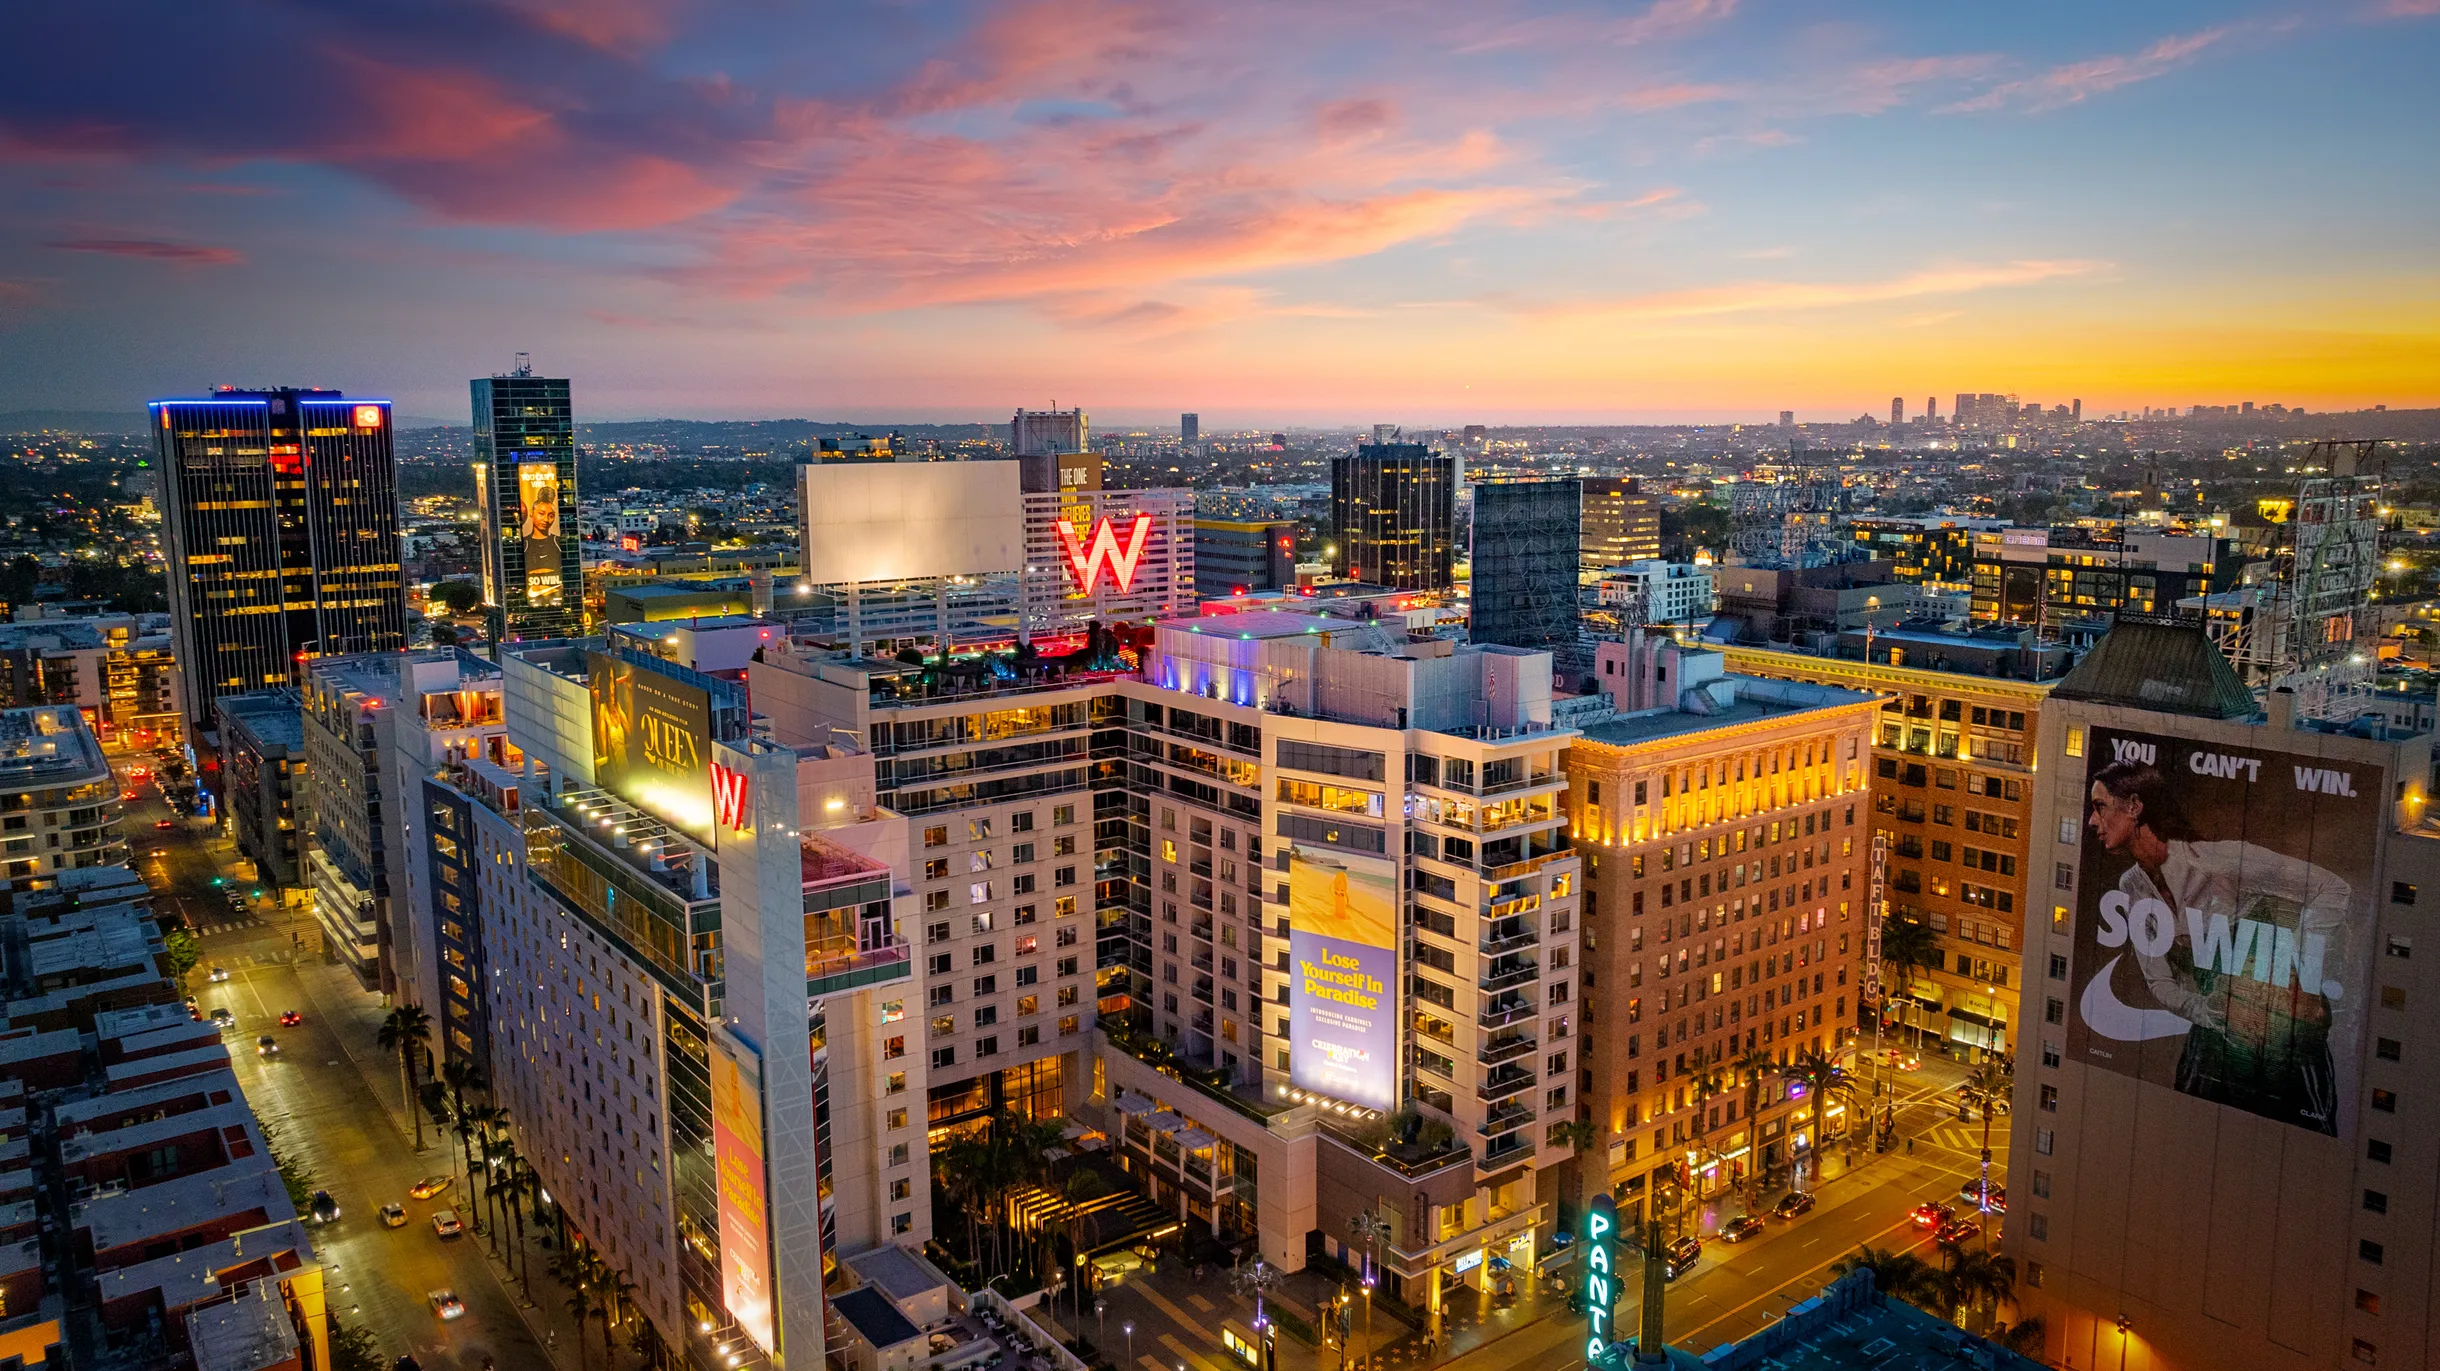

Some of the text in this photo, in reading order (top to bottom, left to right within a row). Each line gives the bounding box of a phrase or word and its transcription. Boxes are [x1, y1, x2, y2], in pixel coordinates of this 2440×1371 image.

[1060, 467, 1087, 486] THE ONE
[1057, 516, 1151, 597] W
[528, 575, 562, 586] SO WIN.
[637, 684, 652, 693] BASED
[668, 694, 680, 704] TRUE
[682, 698, 699, 710] STORY
[641, 714, 699, 772] QUEEN
[657, 759, 664, 770] OF
[2111, 738, 2358, 798] YOU CAN'T WIN.
[710, 761, 748, 831] W
[1867, 848, 1884, 994] TAFT BLDG
[1322, 948, 1360, 970] Lose
[2097, 890, 2344, 1000] SO WIN.
[1300, 960, 1384, 994] Yourself In
[1304, 979, 1378, 1010] Paradise
[1310, 1007, 1372, 1028] INTRODUCING CARNIVAL'S
[1316, 1016, 1366, 1033] EXCLUSIVE PARADISE
[2090, 1048, 2112, 1059] CAITLIN
[728, 1145, 748, 1178] Lose
[718, 1155, 763, 1212] Yourself In
[722, 1181, 760, 1229] Paradise
